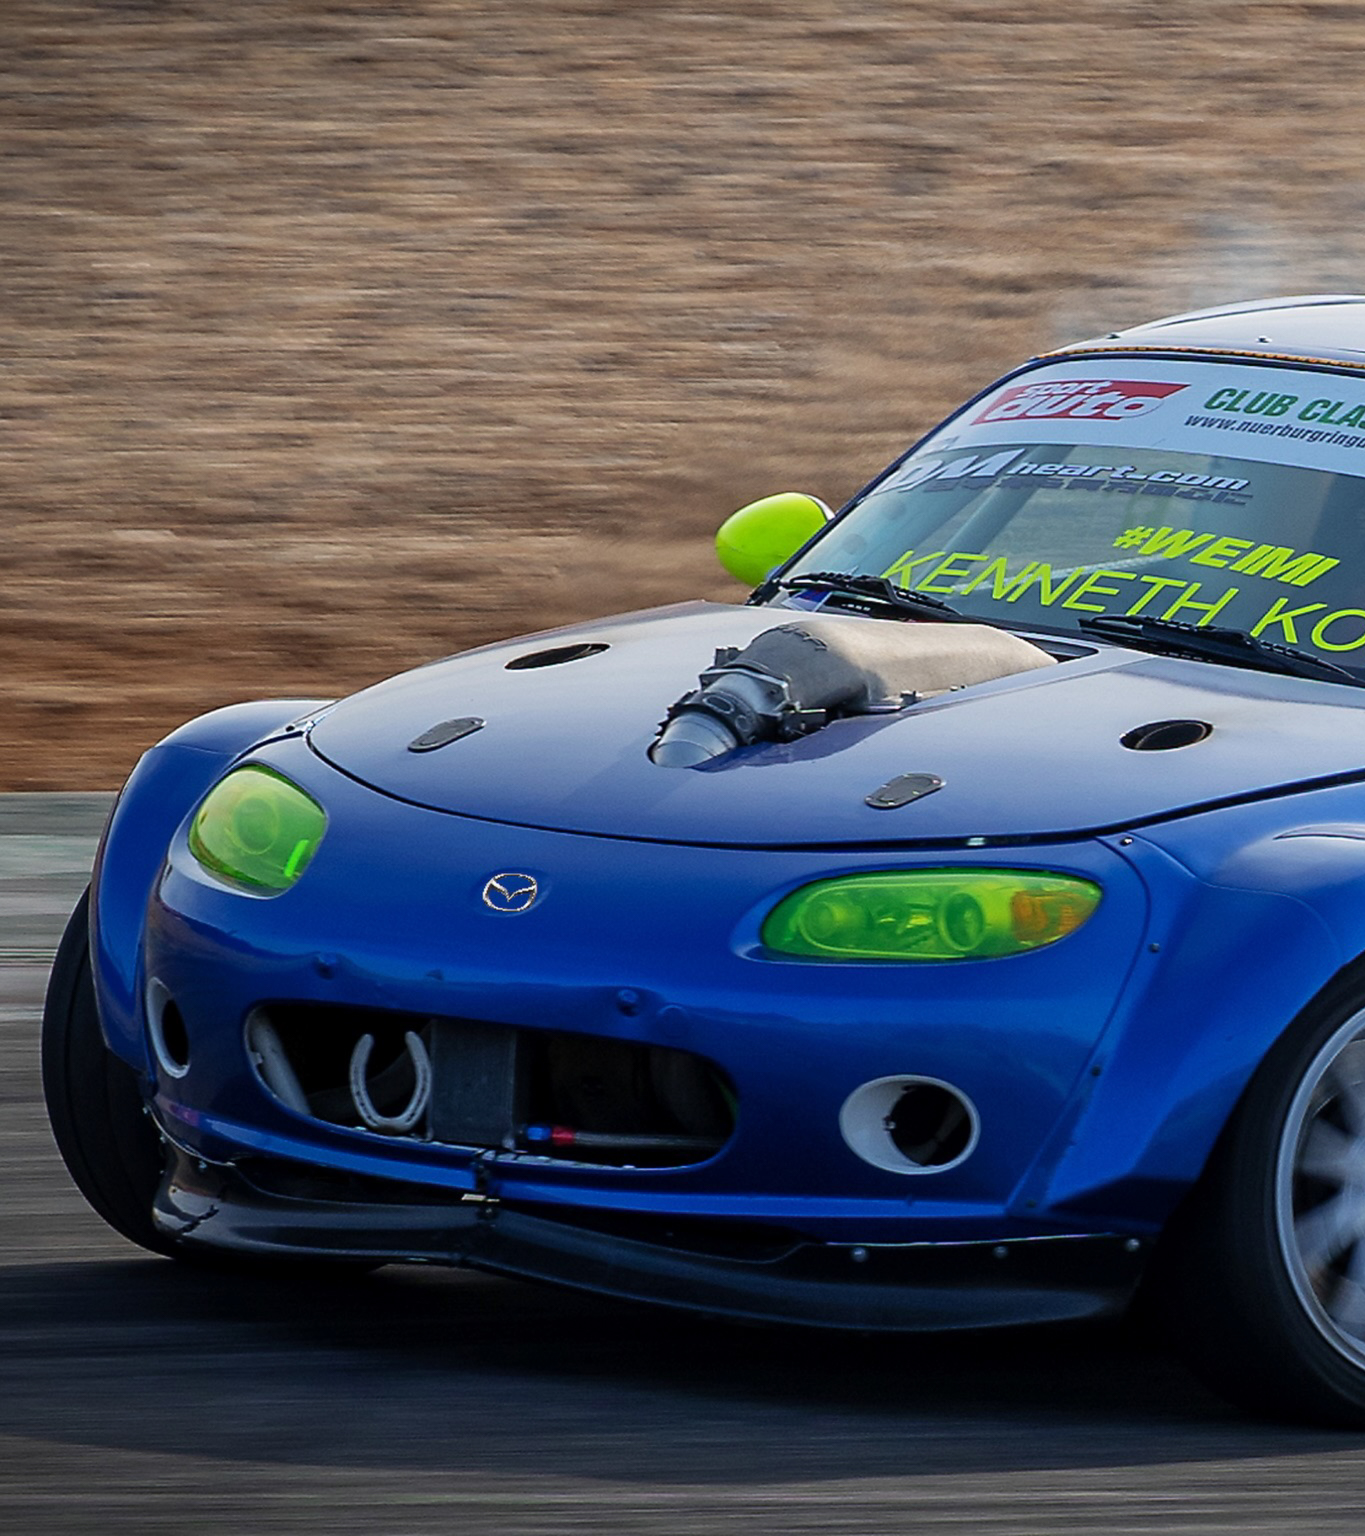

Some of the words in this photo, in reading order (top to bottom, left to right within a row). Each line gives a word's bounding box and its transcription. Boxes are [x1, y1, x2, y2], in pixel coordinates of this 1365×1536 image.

[984, 391, 1166, 420] auto
[1203, 388, 1299, 417] CLUB
[1112, 525, 1341, 588] #WEIMI
[880, 549, 1240, 628] KENNETH
